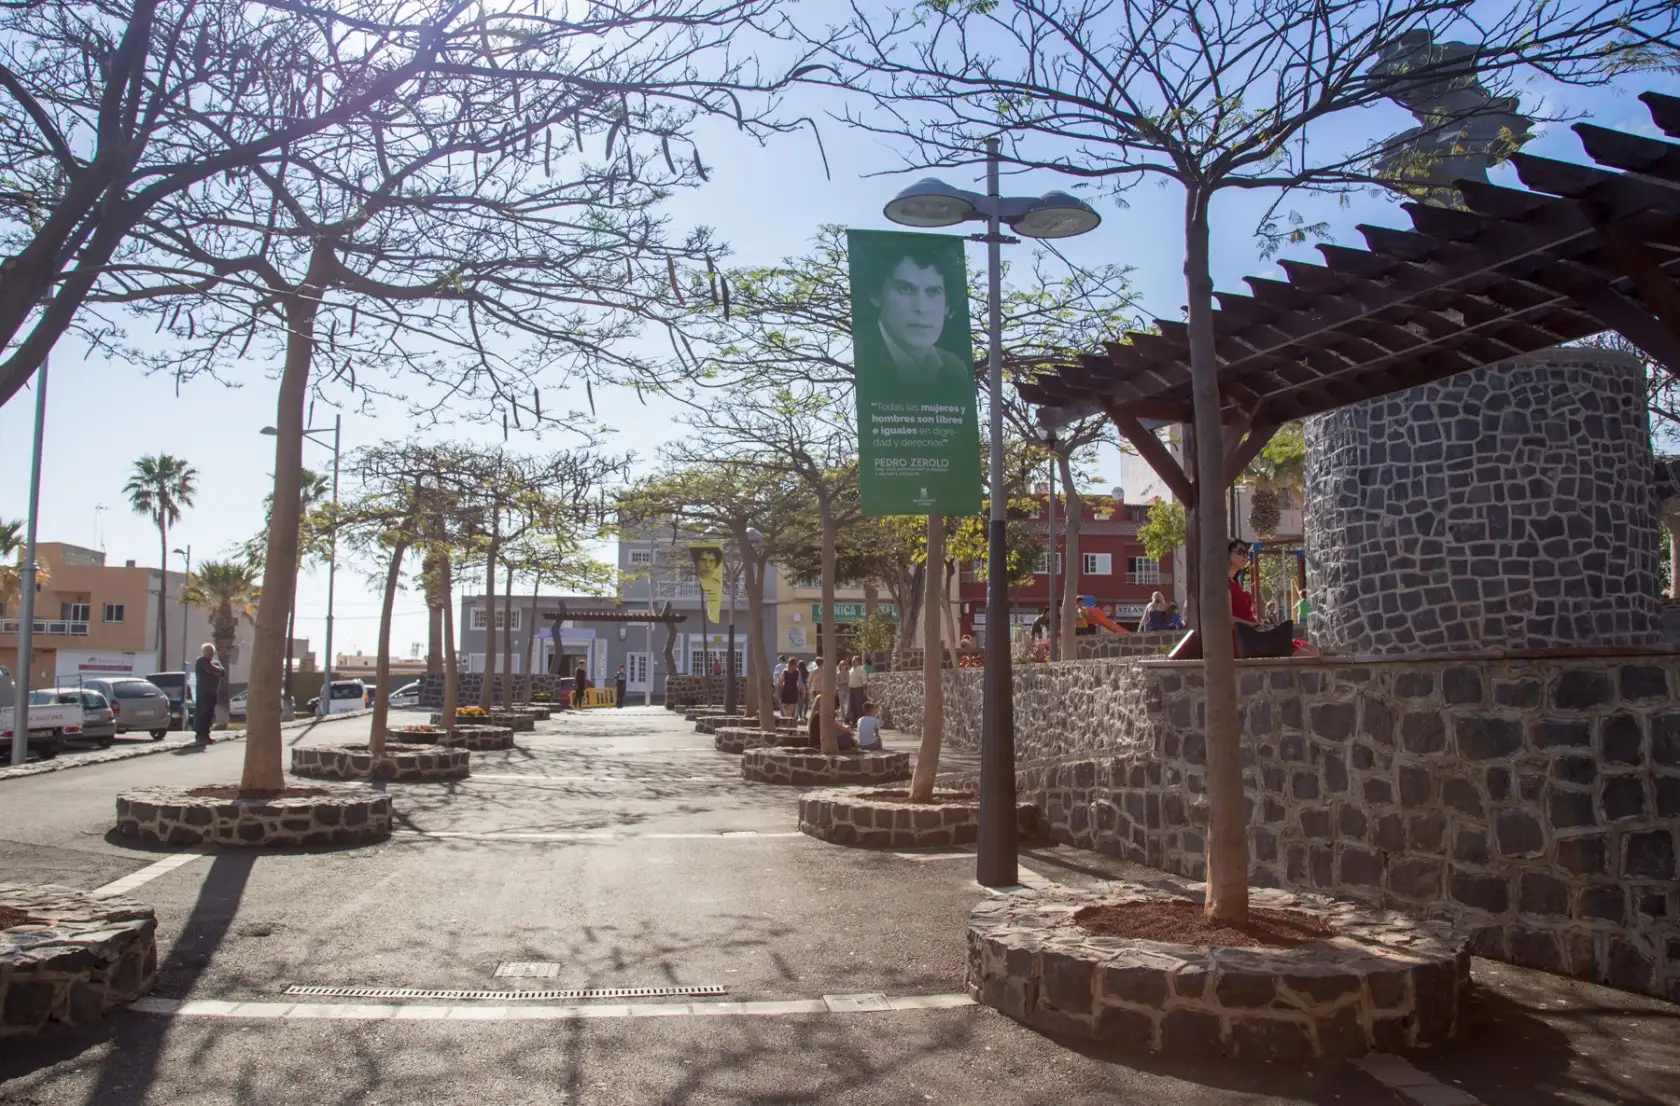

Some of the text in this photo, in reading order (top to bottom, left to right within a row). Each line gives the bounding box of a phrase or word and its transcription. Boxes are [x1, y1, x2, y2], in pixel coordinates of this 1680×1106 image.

[920, 403, 959, 413] mujeres
[960, 406, 966, 415] y
[872, 414, 915, 423] hombres
[936, 415, 963, 424] libres
[880, 425, 917, 436] iguales
[873, 438, 892, 446] dad
[874, 458, 949, 467] PEDRO ZEROLO
[818, 605, 857, 616] CNICA
